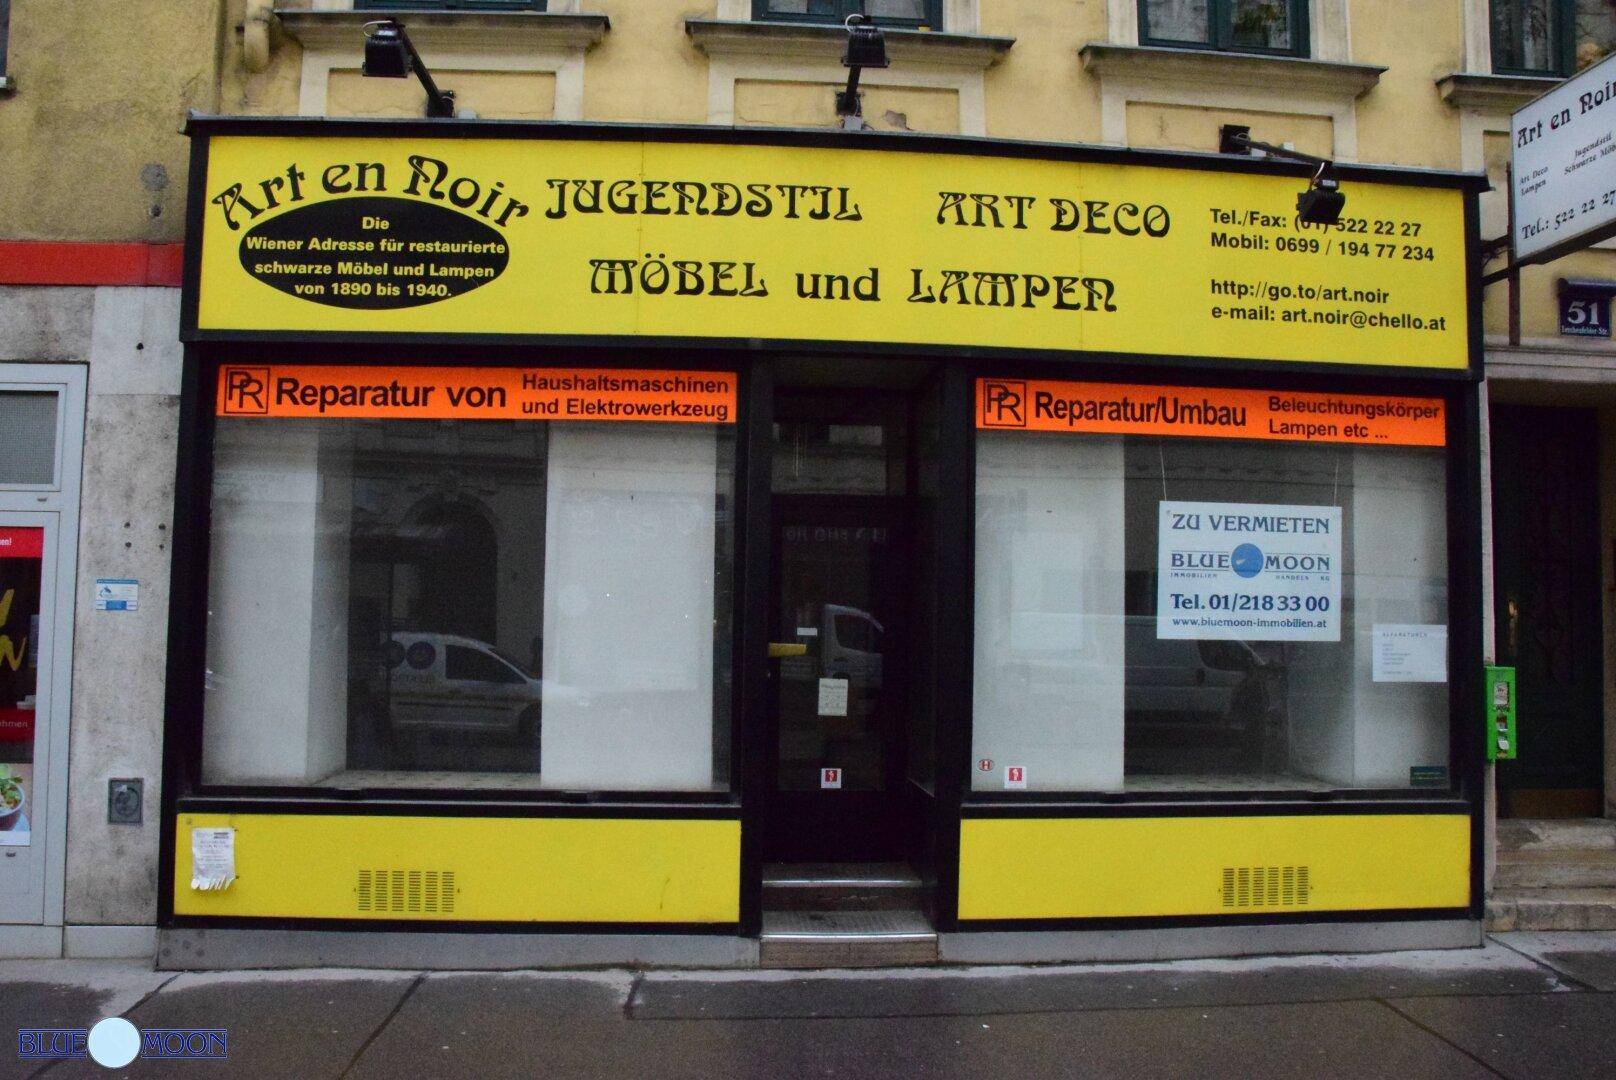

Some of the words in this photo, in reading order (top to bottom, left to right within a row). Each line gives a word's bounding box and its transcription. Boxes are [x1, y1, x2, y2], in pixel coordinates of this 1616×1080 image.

[1518, 120, 1543, 148] Art
[1551, 108, 1571, 130] en
[212, 163, 306, 231] Art
[321, 162, 387, 194] en
[402, 154, 529, 227] Noir
[1521, 180, 1547, 196] Lampen
[545, 178, 863, 221] JUGENDSTIL
[936, 191, 1036, 229] ART
[1049, 198, 1171, 237] DECO
[1521, 217, 1549, 239] Tel.:
[1555, 209, 1575, 230] 522
[1582, 199, 1596, 214] 22
[362, 217, 390, 230] Die
[1210, 208, 1287, 228] Tel./Fax:
[1335, 217, 1368, 234] 522
[1374, 220, 1395, 235] 22
[1401, 222, 1421, 237] 27
[246, 236, 303, 250] Wiener
[309, 237, 375, 252] Adresse
[380, 239, 404, 252] für
[409, 240, 506, 254] restaurierte
[1211, 232, 1269, 250] Mobil:
[1276, 237, 1320, 253] 0699
[1326, 239, 1332, 255] /
[1339, 241, 1370, 256] 194
[1375, 243, 1396, 258] 77
[1403, 245, 1434, 261] 234
[254, 262, 332, 275] schwarze
[337, 262, 388, 276] Möbel
[393, 263, 424, 276] und
[429, 264, 494, 279] Lampen
[589, 253, 768, 297] MÖBEL
[795, 267, 881, 301] und
[907, 268, 1117, 312] LAMPEN
[294, 284, 324, 295] von
[331, 283, 371, 296] 1890
[376, 283, 400, 296] bis
[407, 284, 452, 297] 1940.
[1211, 279, 1389, 304] http://go.to/art.noir
[1211, 306, 1275, 321] e-mail:
[1282, 308, 1446, 331] art.noir@chello.at
[1568, 301, 1599, 325] 51
[276, 377, 435, 411] Reparatur
[446, 384, 506, 408] von
[522, 374, 729, 394] Haushaltsmaschinen
[522, 398, 559, 416] und
[566, 398, 729, 421] Elektrowerkzeug
[1035, 391, 1247, 427] Reparatur/Umbau
[1269, 396, 1440, 421] Beleuchtungskörper
[1269, 418, 1337, 438] Lampen
[1343, 421, 1369, 438] etc
[1172, 514, 1200, 530] ZU
[1208, 515, 1330, 534] VERMIETEN
[1170, 554, 1229, 568] BLUE
[1264, 556, 1330, 571] MOON
[1170, 593, 1205, 610] Tel.
[1209, 594, 1274, 612] 01/218
[1278, 596, 1301, 611] 33
[1306, 596, 1330, 611] 00
[1172, 617, 1327, 629] www.bluemoon-immobilien.at
